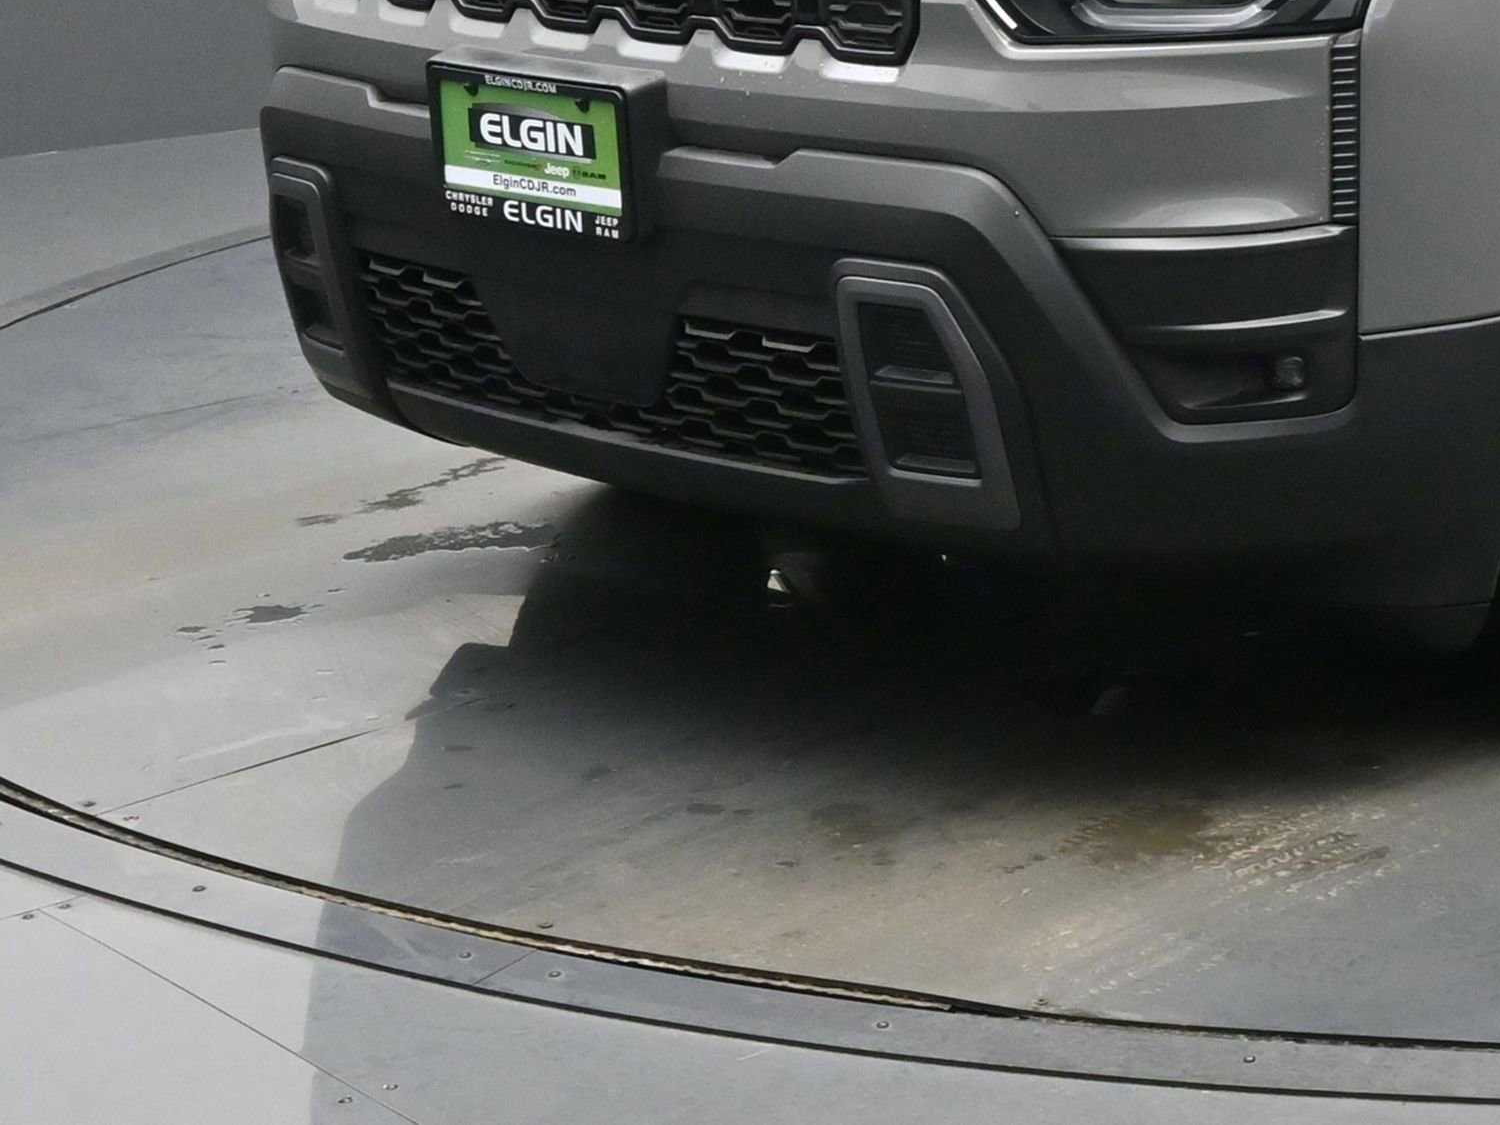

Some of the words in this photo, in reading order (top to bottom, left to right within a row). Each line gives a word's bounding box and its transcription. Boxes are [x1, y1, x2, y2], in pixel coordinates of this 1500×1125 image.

[479, 113, 584, 156] ELGIN
[544, 162, 570, 178] Jeep
[493, 175, 577, 197] ElginCDJR.com
[445, 190, 494, 207] CHRYSLER
[450, 202, 489, 217] DODGE
[503, 199, 583, 233] ELGIN
[594, 215, 619, 227] JEEP
[595, 226, 619, 239] RAM
